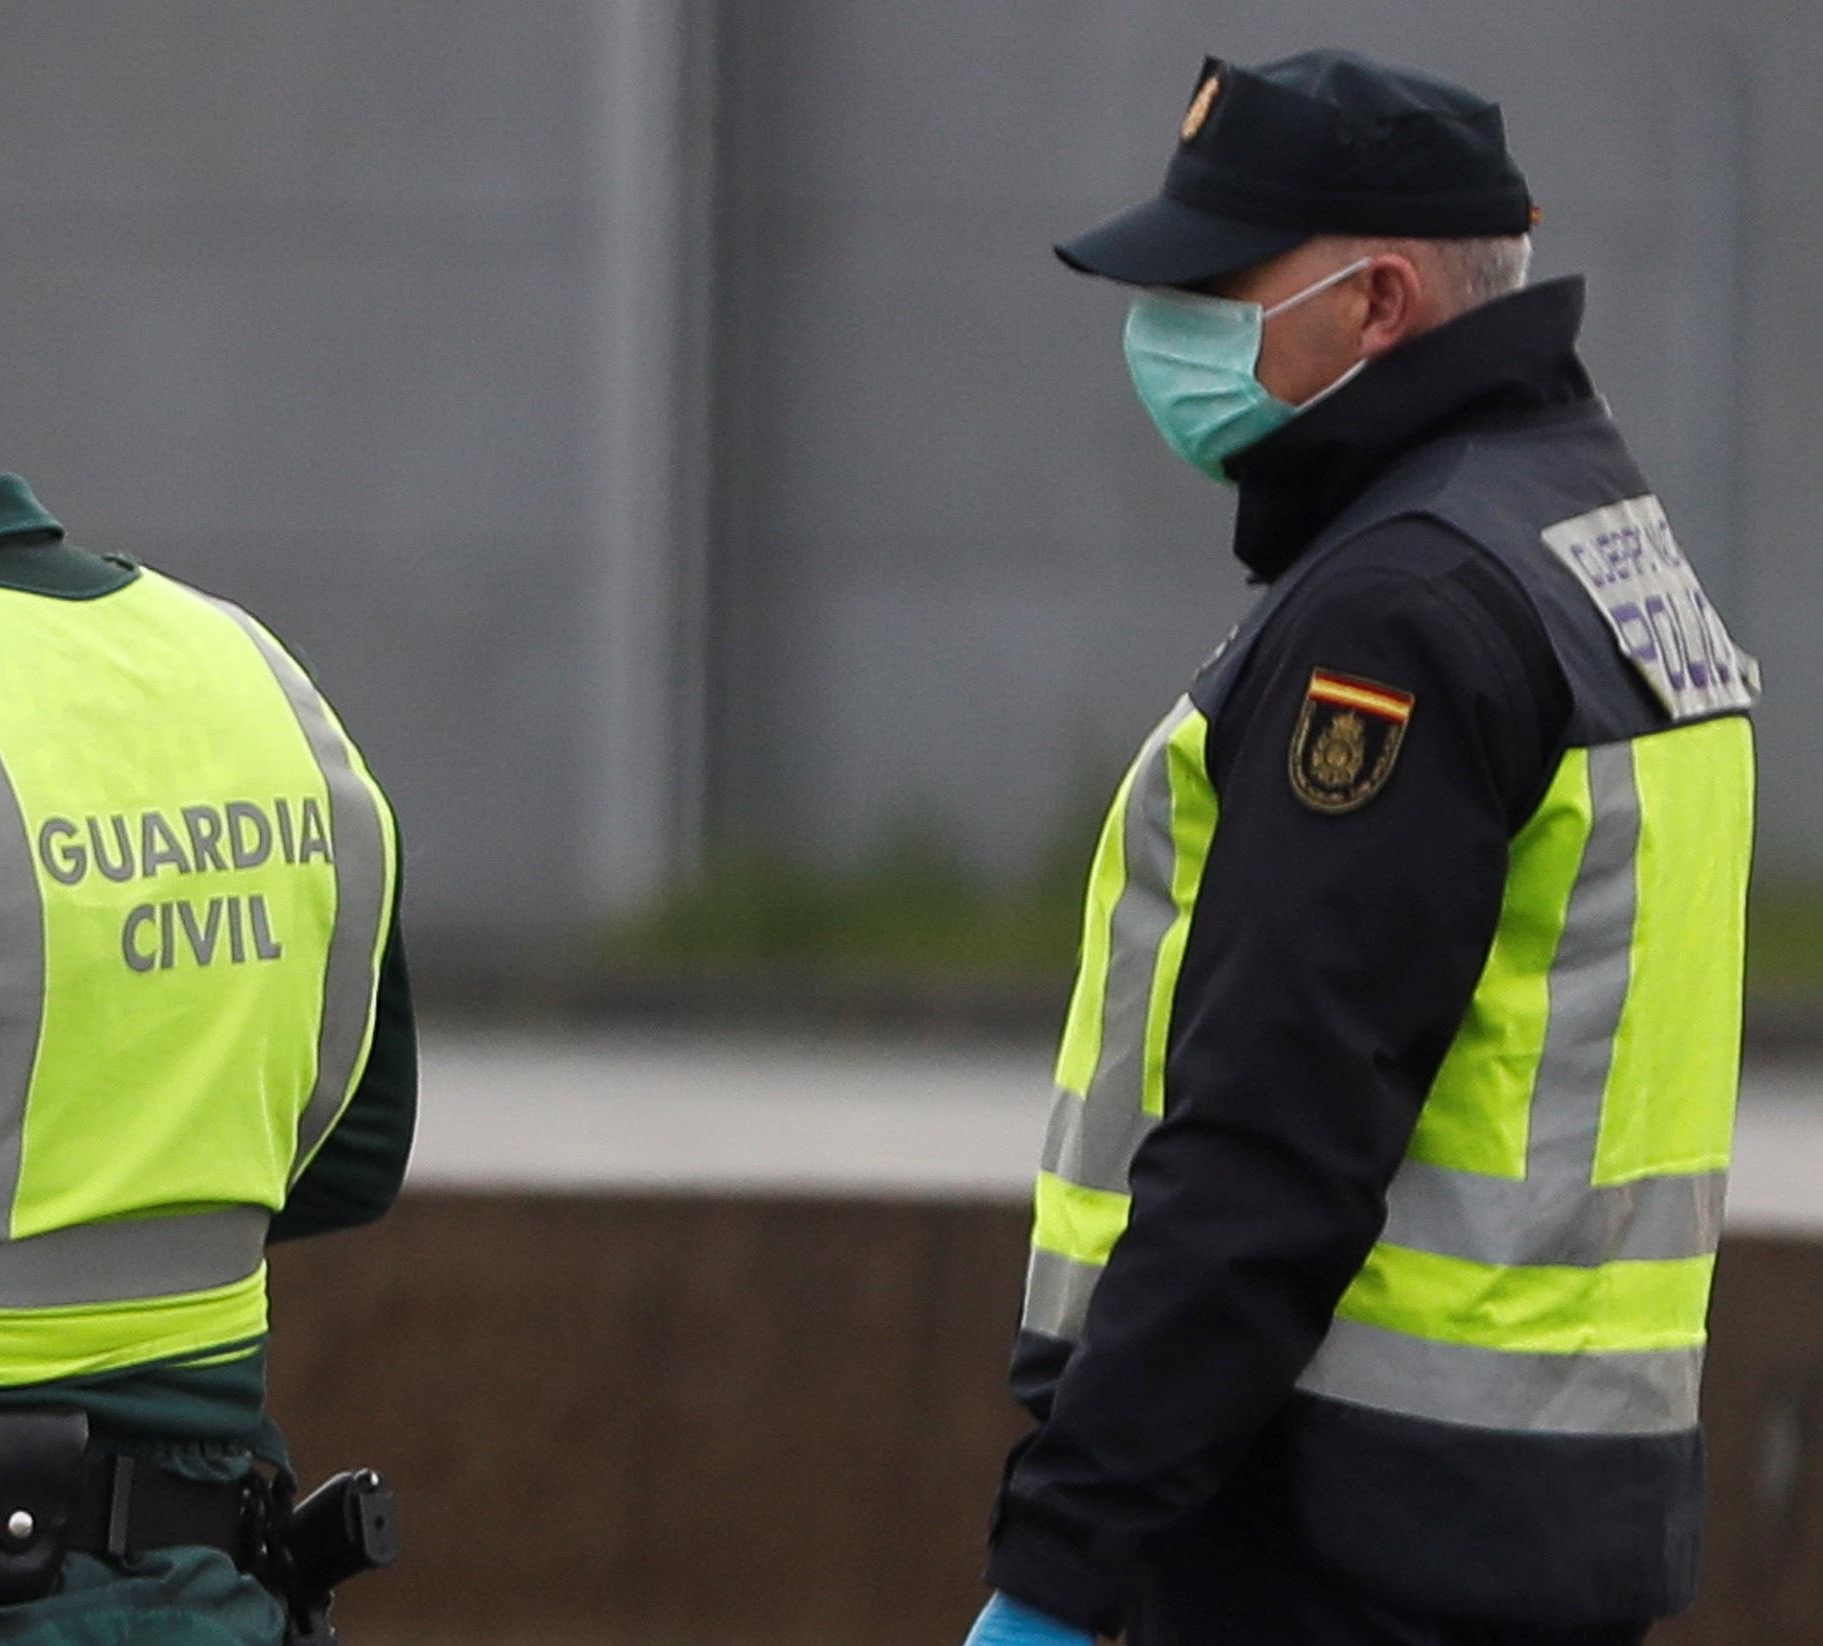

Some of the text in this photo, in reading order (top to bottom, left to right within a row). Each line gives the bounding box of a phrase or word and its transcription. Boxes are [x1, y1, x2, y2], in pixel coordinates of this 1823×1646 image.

[1609, 588, 1731, 692] POLIC
[39, 797, 335, 885] GUARDIA
[122, 894, 282, 973] CIVIL
